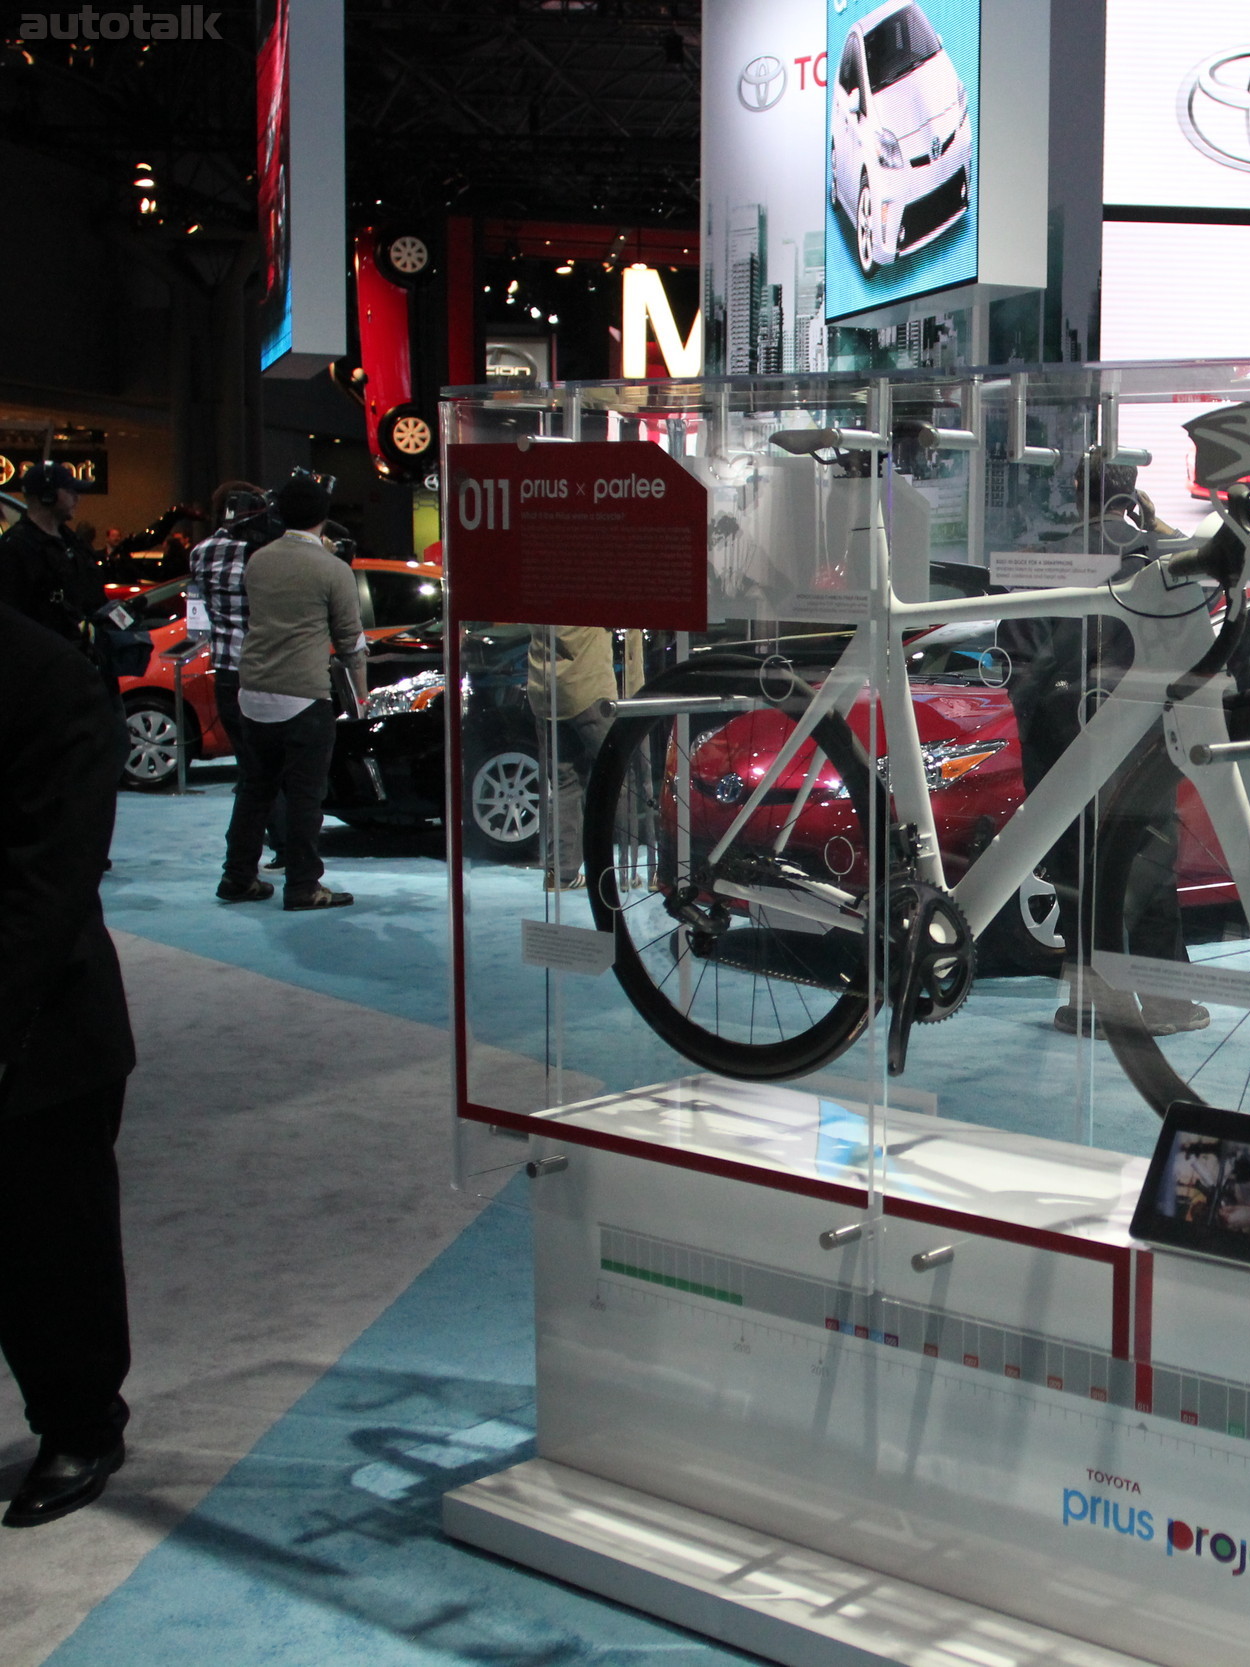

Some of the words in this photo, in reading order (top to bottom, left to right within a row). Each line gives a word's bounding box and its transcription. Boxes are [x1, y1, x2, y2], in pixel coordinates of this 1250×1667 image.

[486, 366, 531, 376] cion
[458, 478, 510, 530] 011
[520, 478, 568, 503] prius
[594, 473, 666, 504] parlee
[1137, 1402, 1150, 1412] 011
[1086, 1468, 1142, 1495] TOYOTA
[1063, 1488, 1154, 1541] prius
